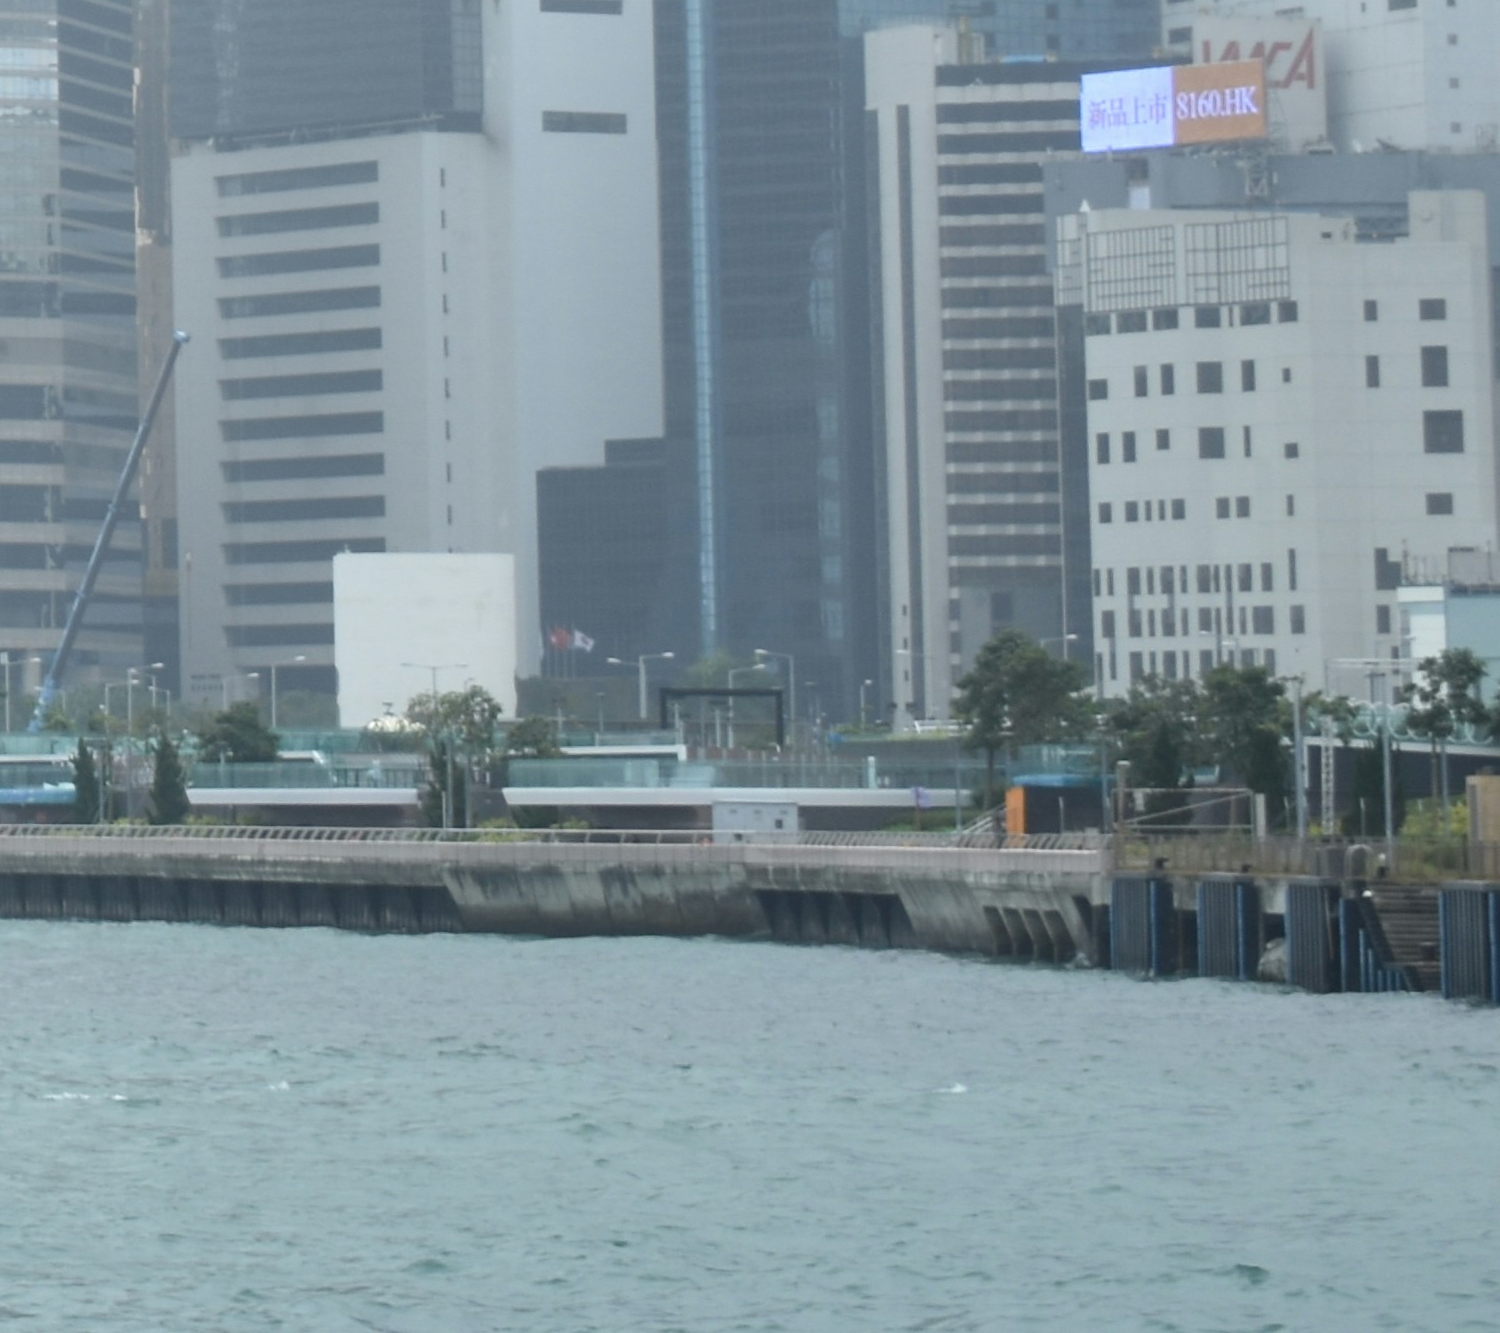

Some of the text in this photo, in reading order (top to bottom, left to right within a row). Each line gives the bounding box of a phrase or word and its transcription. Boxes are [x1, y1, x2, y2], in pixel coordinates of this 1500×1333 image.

[1088, 93, 1167, 130] 新品上市
[1176, 86, 1259, 120] 8160.HK
